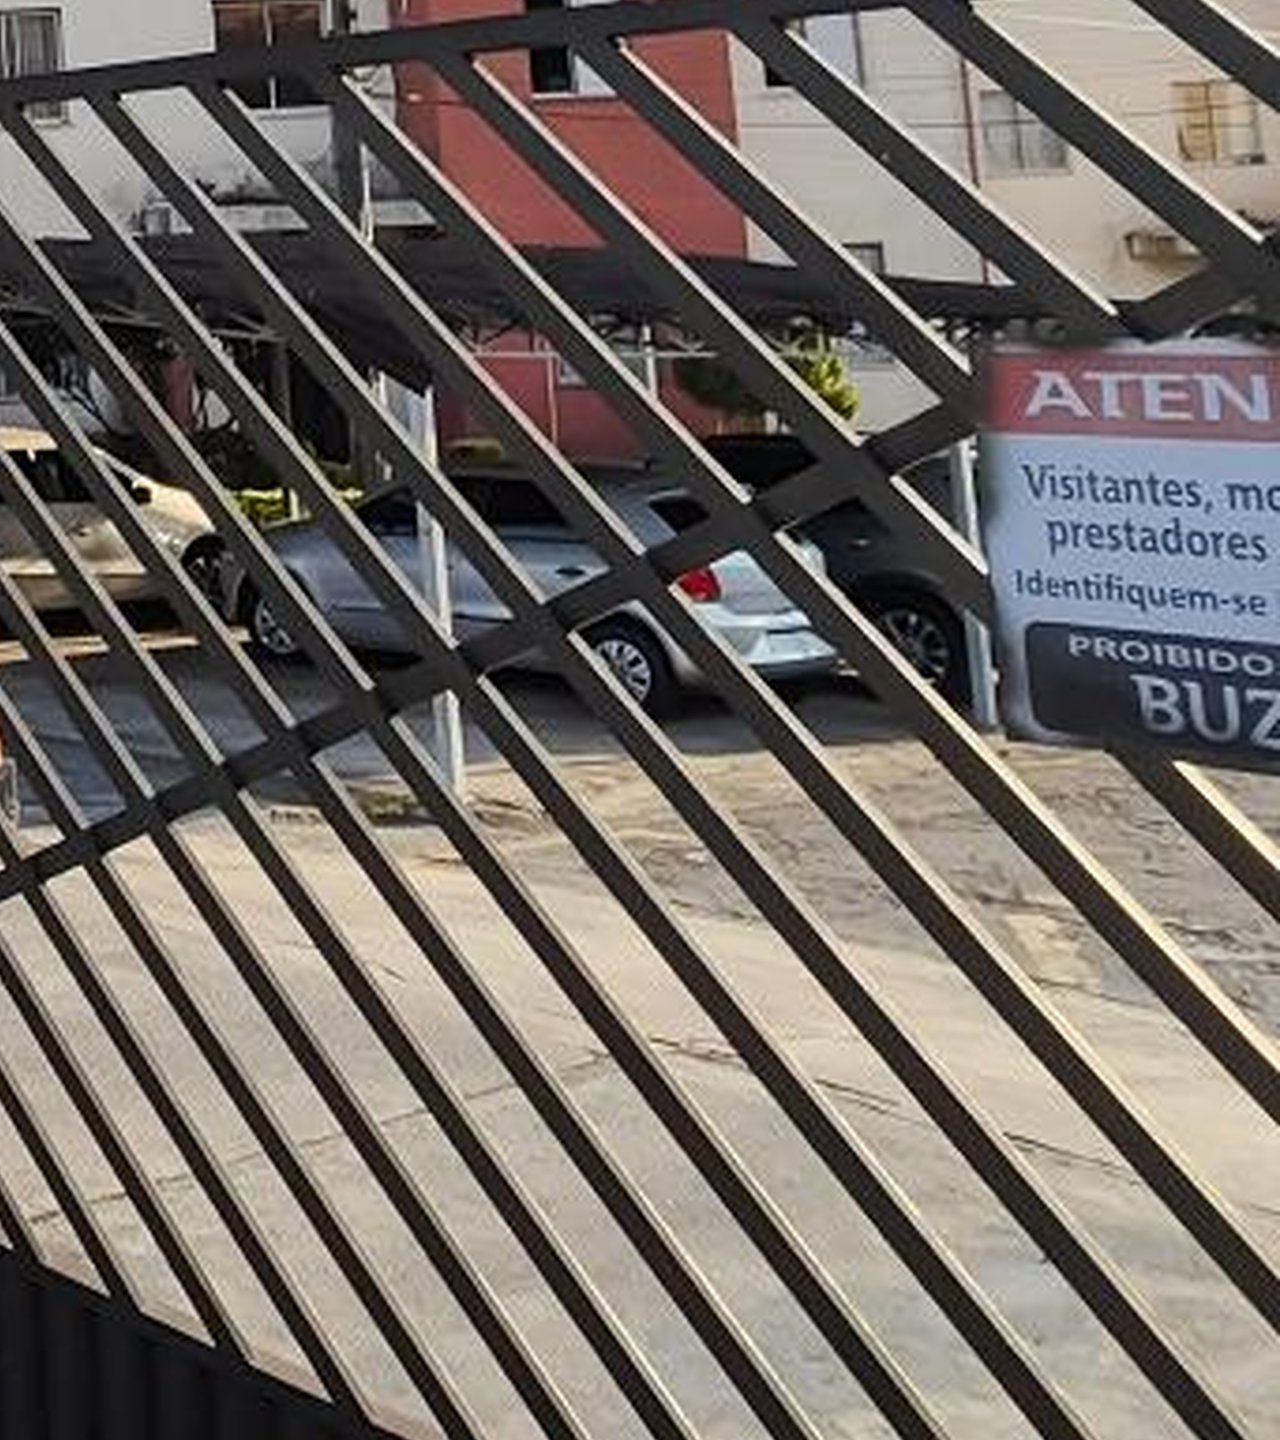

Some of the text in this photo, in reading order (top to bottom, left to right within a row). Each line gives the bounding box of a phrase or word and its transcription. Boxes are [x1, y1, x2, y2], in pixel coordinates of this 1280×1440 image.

[1024, 369, 1271, 422] ATEN
[1021, 463, 1214, 515] Visitantes,
[1045, 516, 1268, 563] prestadores
[1013, 568, 1268, 617] Identifiquem-se
[1067, 632, 1275, 677] PROIBIDO
